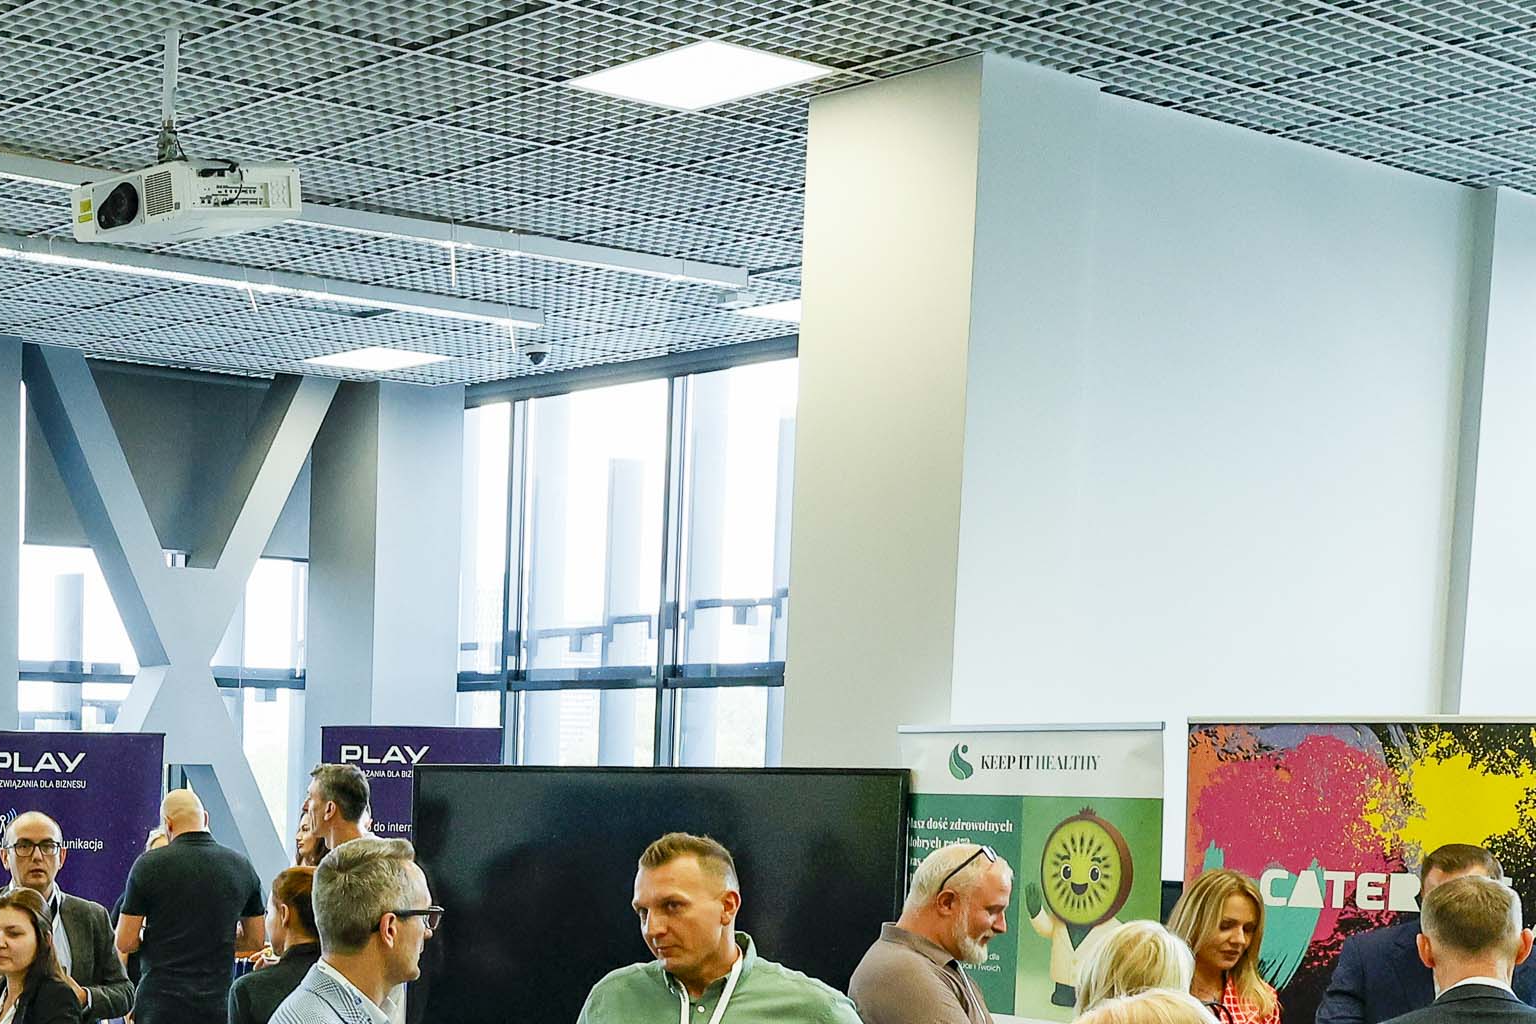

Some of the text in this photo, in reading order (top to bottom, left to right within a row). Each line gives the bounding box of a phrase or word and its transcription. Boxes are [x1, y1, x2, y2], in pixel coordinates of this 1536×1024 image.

[340, 745, 430, 764] PLAY
[981, 755, 1102, 771] KEEP IT HEALTHY
[39, 780, 54, 788] DLA
[55, 780, 86, 789] BIZNESU
[373, 821, 385, 832] do
[926, 817, 948, 830] dość
[949, 818, 1013, 834] zdrowotnych
